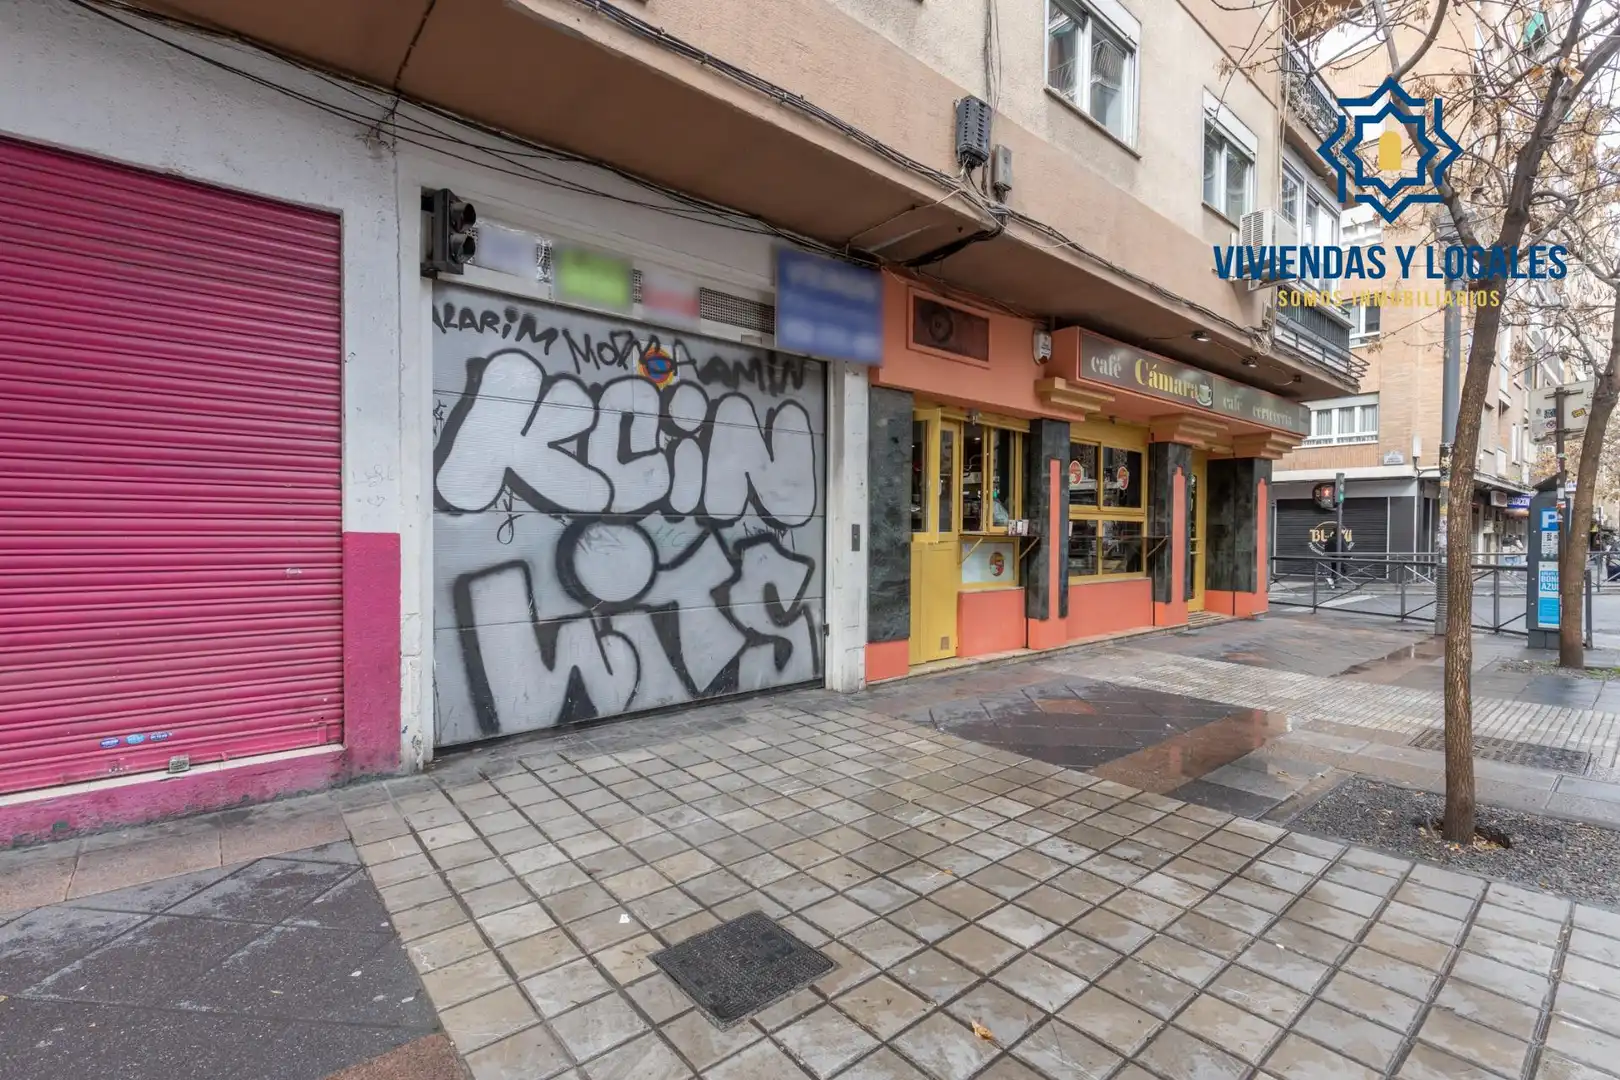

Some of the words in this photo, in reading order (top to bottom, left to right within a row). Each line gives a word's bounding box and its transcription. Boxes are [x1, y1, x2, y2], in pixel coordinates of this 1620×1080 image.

[1090, 353, 1122, 379] café
[1134, 357, 1201, 399] Cámara
[1541, 510, 1558, 528] P
